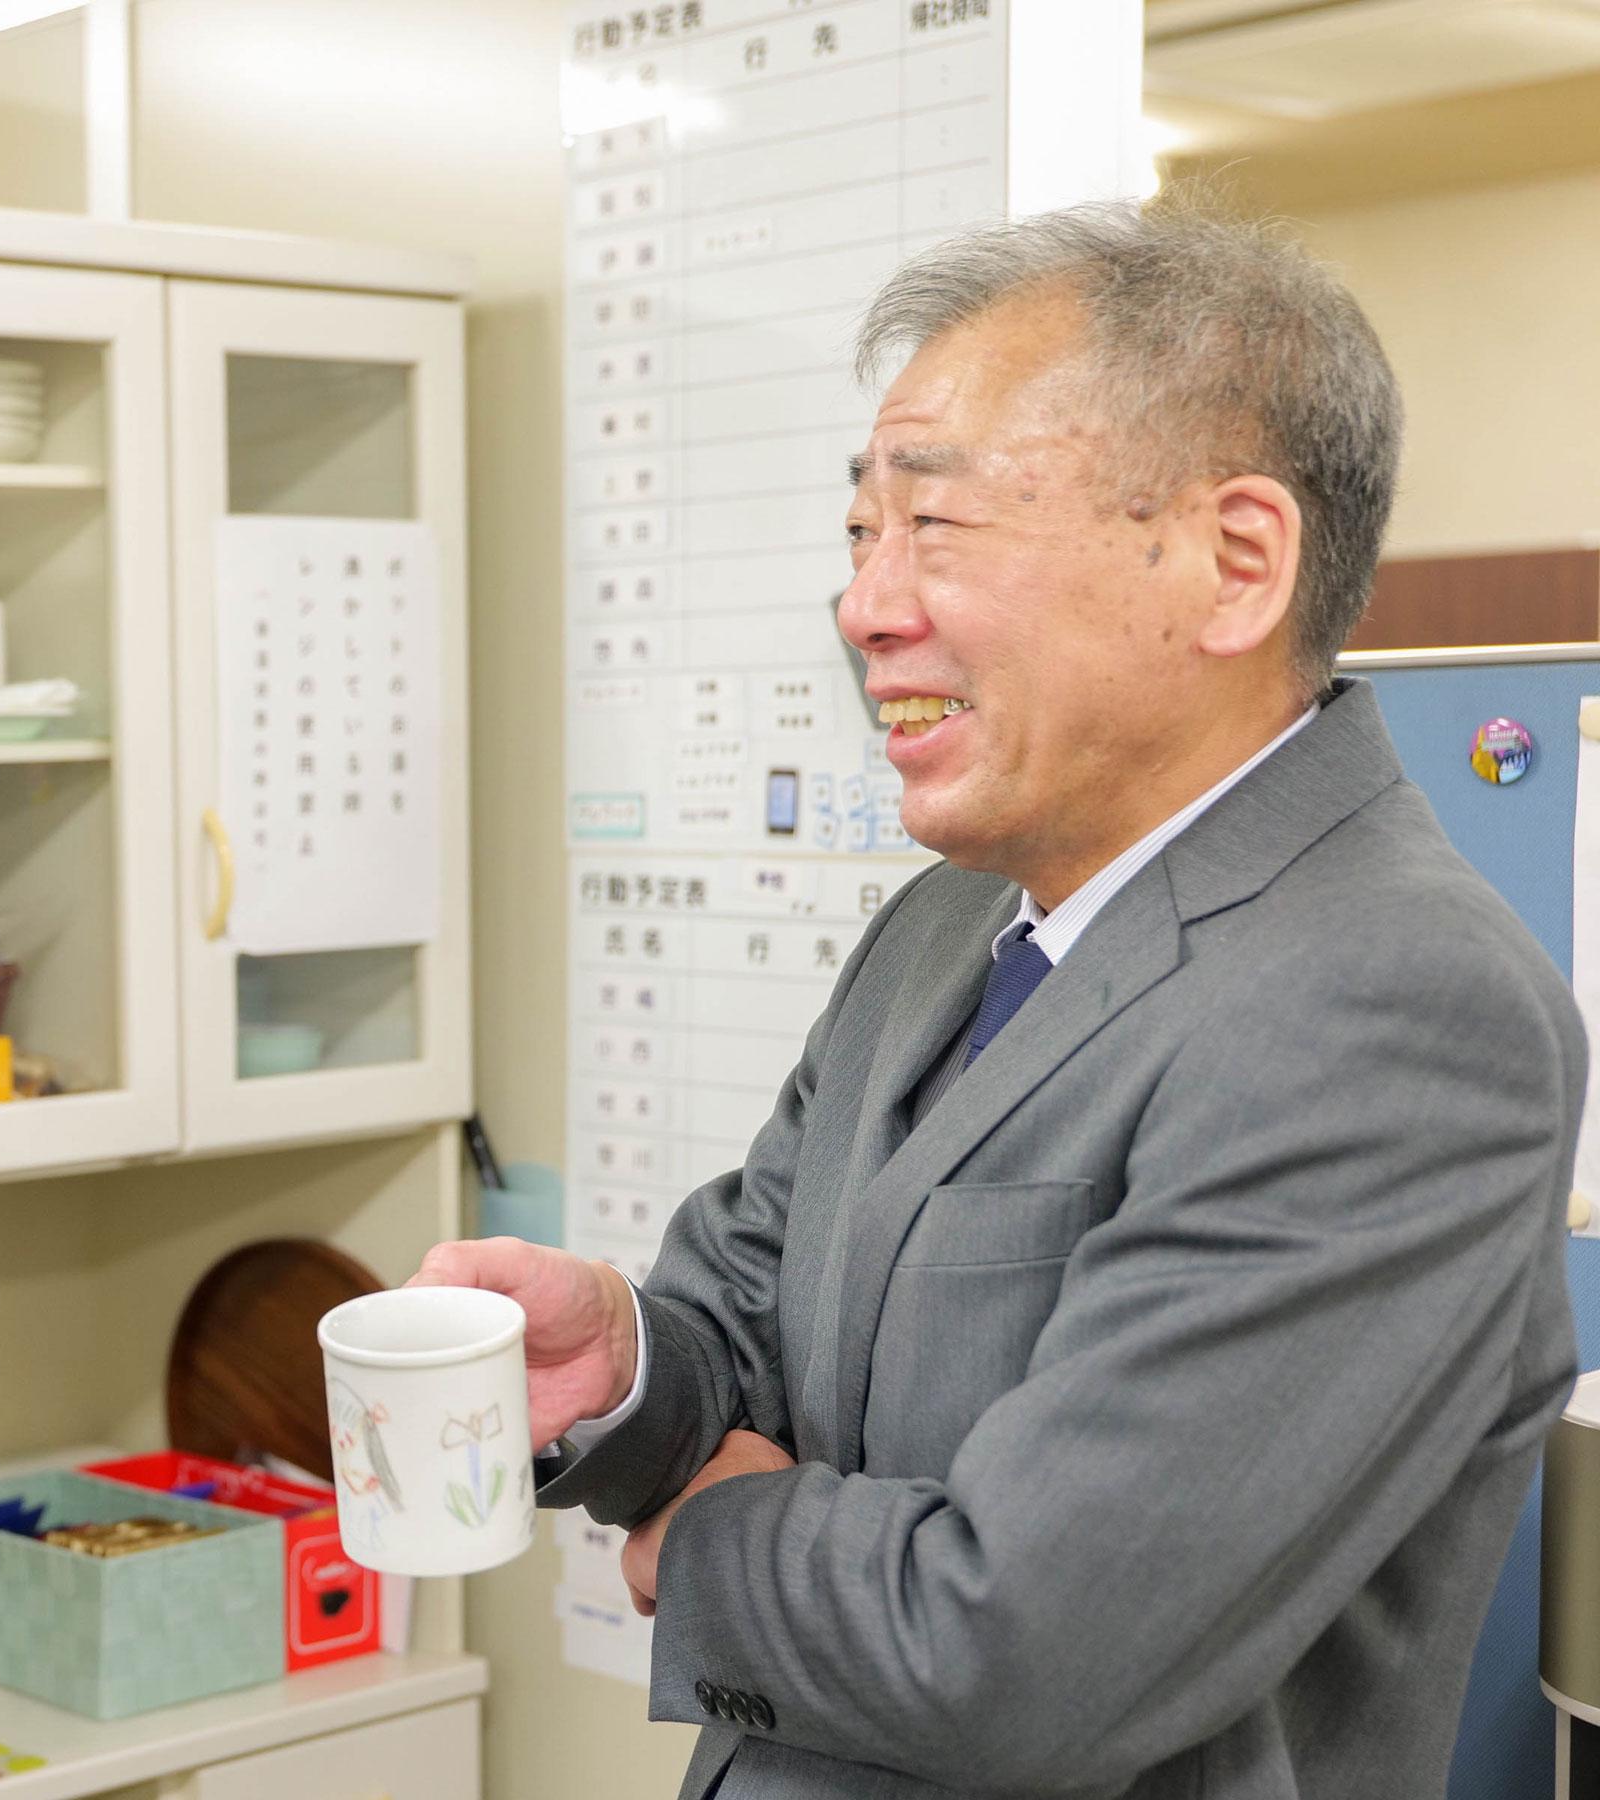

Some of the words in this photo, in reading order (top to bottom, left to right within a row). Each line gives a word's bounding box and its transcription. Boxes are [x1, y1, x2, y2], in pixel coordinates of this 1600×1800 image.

[581, 873, 708, 908] 行動予定表
